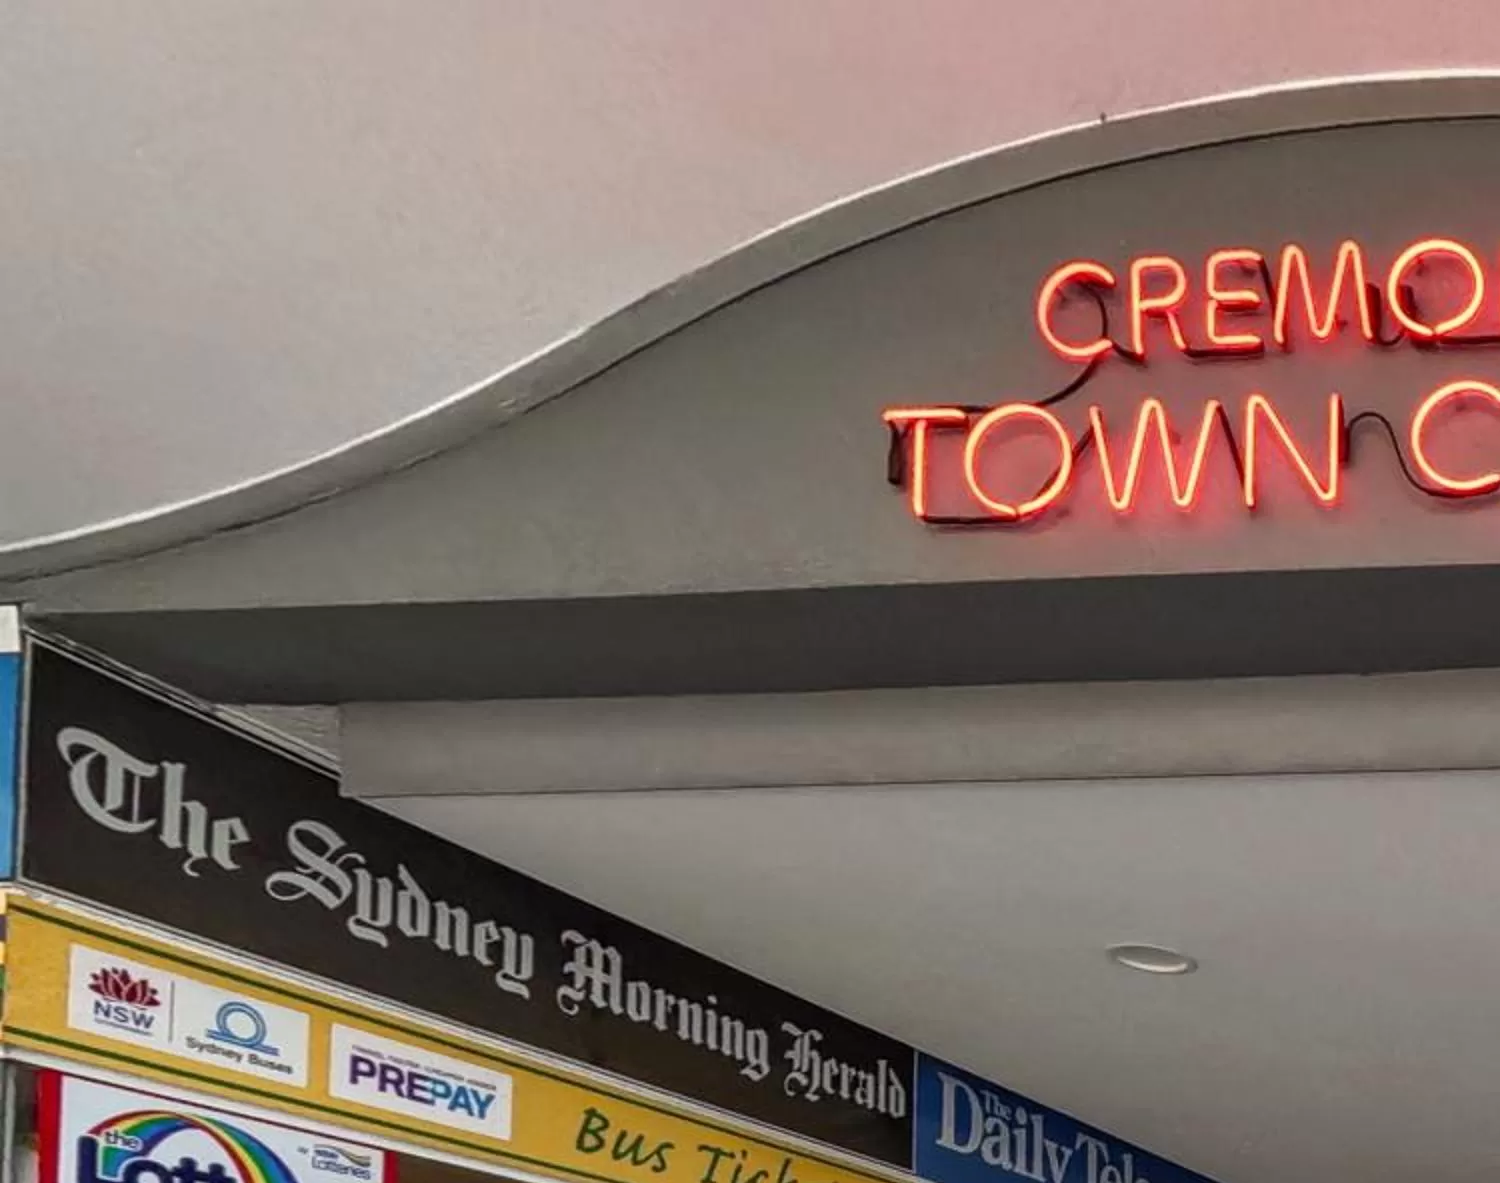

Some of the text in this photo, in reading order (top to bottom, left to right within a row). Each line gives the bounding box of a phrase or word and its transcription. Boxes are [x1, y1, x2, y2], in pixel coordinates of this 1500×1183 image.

[883, 394, 1344, 519] TOWN
[56, 727, 906, 1119] The Sydney Morning Herald
[94, 1000, 155, 1030] NSW
[185, 1035, 294, 1075] Sydney Buses
[349, 1055, 496, 1120] PREPAY
[105, 1131, 140, 1149] the
[575, 1106, 675, 1173] Bus
